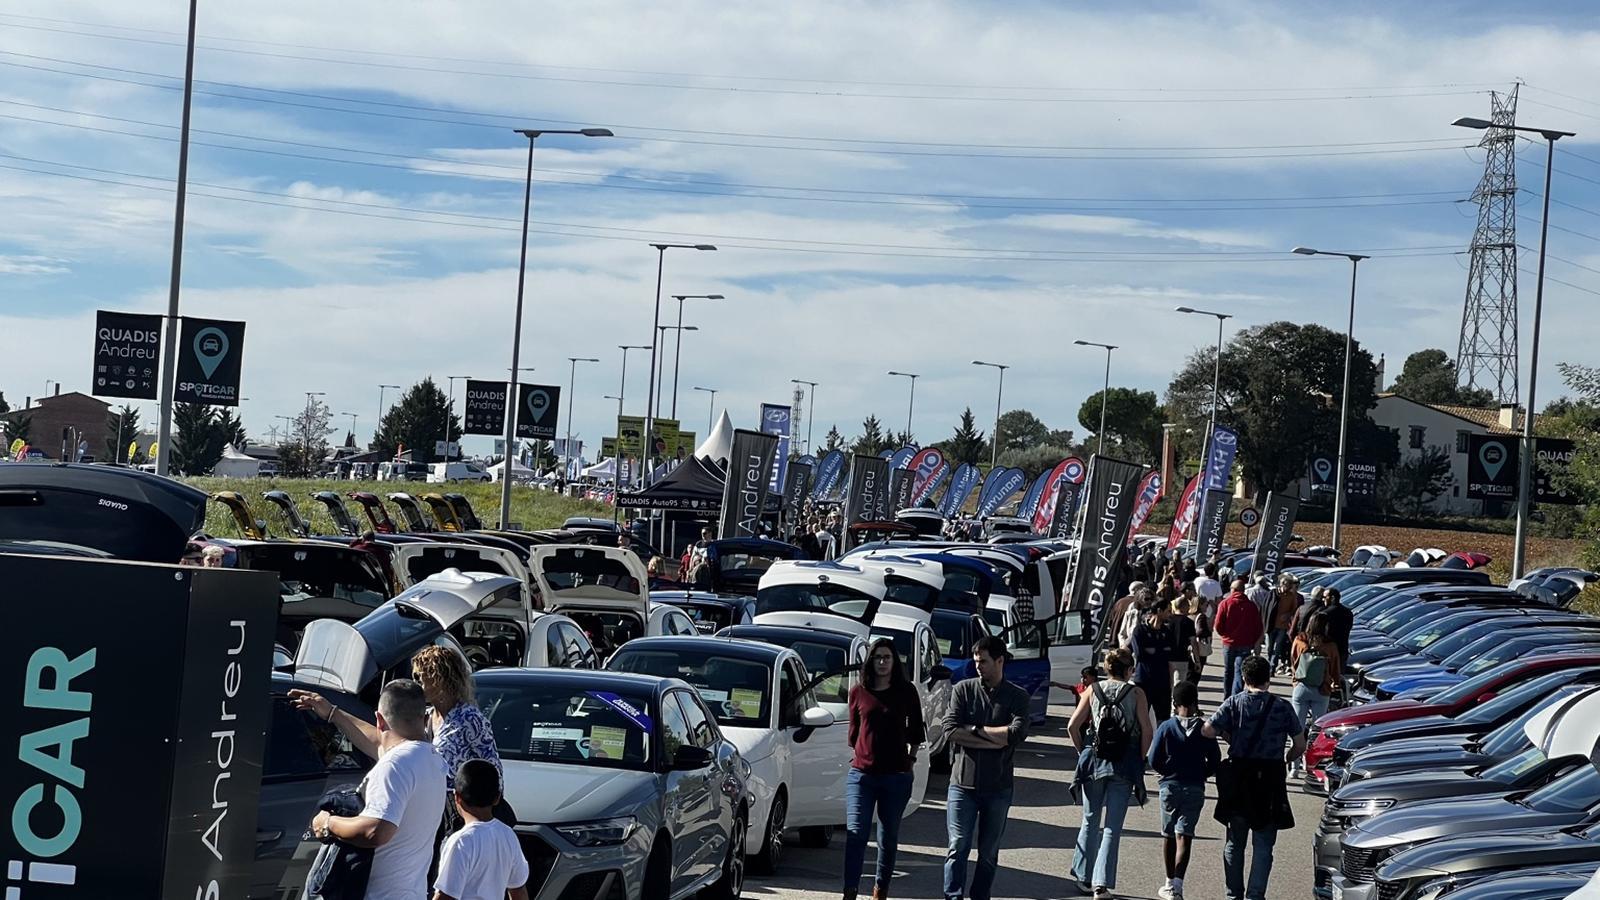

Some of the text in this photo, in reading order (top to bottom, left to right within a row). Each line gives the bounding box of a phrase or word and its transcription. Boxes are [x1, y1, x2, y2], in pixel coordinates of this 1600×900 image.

[98, 327, 158, 344] QUADIS
[98, 341, 155, 359] Andreu
[467, 390, 505, 401] QUADIS
[467, 399, 504, 410] Andreu
[1347, 463, 1376, 473] QUADIS
[1347, 471, 1376, 480] Andreu
[620, 497, 650, 505] QUADIS
[738, 455, 761, 534] Andreu
[859, 471, 875, 521] Andreu
[896, 477, 909, 510] Andreu
[985, 474, 1023, 514] HYUNDAI
[98, 498, 129, 511] QUADIS
[1097, 482, 1122, 563] Andreu
[1210, 501, 1225, 536] Andreu
[1243, 513, 1255, 521] 50
[1269, 506, 1289, 549] Andreu
[201, 620, 246, 861] Andreu
